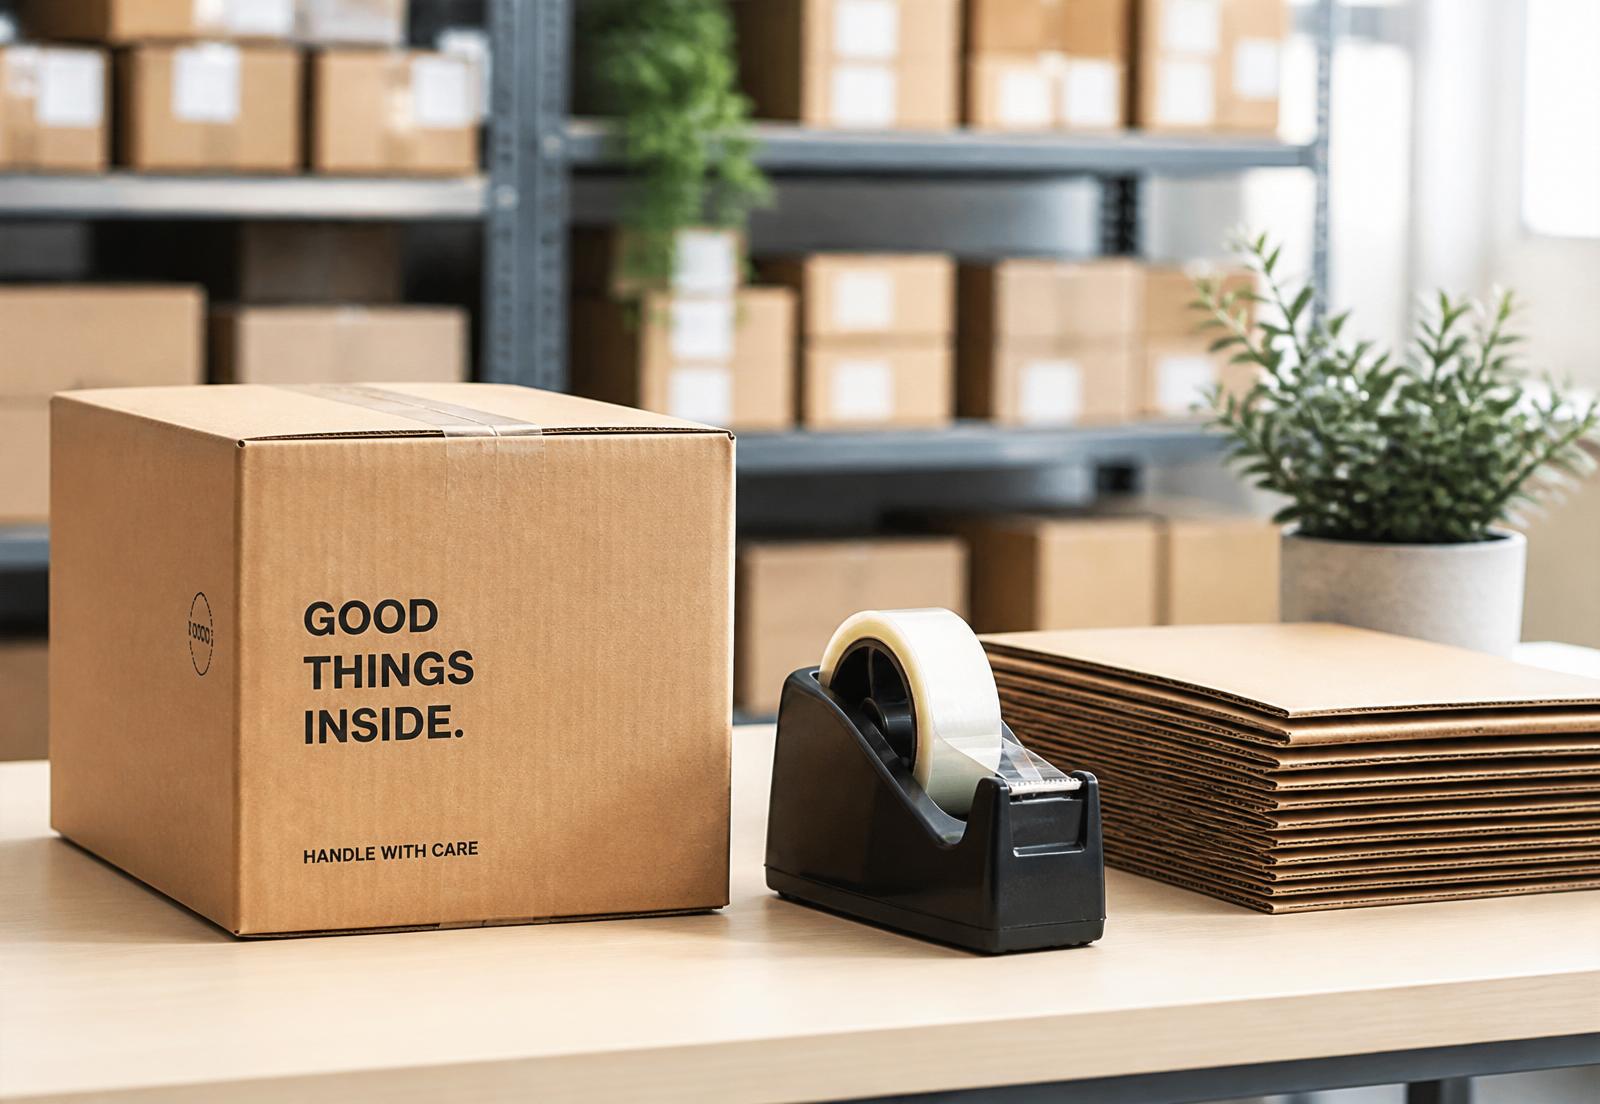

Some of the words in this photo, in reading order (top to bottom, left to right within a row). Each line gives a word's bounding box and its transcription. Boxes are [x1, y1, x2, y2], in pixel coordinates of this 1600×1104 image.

[303, 598, 439, 637] GOOD
[303, 650, 474, 690] THINGS
[304, 704, 464, 745] INSIDE.
[303, 846, 376, 865] HANDLE
[380, 842, 427, 860] WITH
[431, 840, 479, 858] CARE
